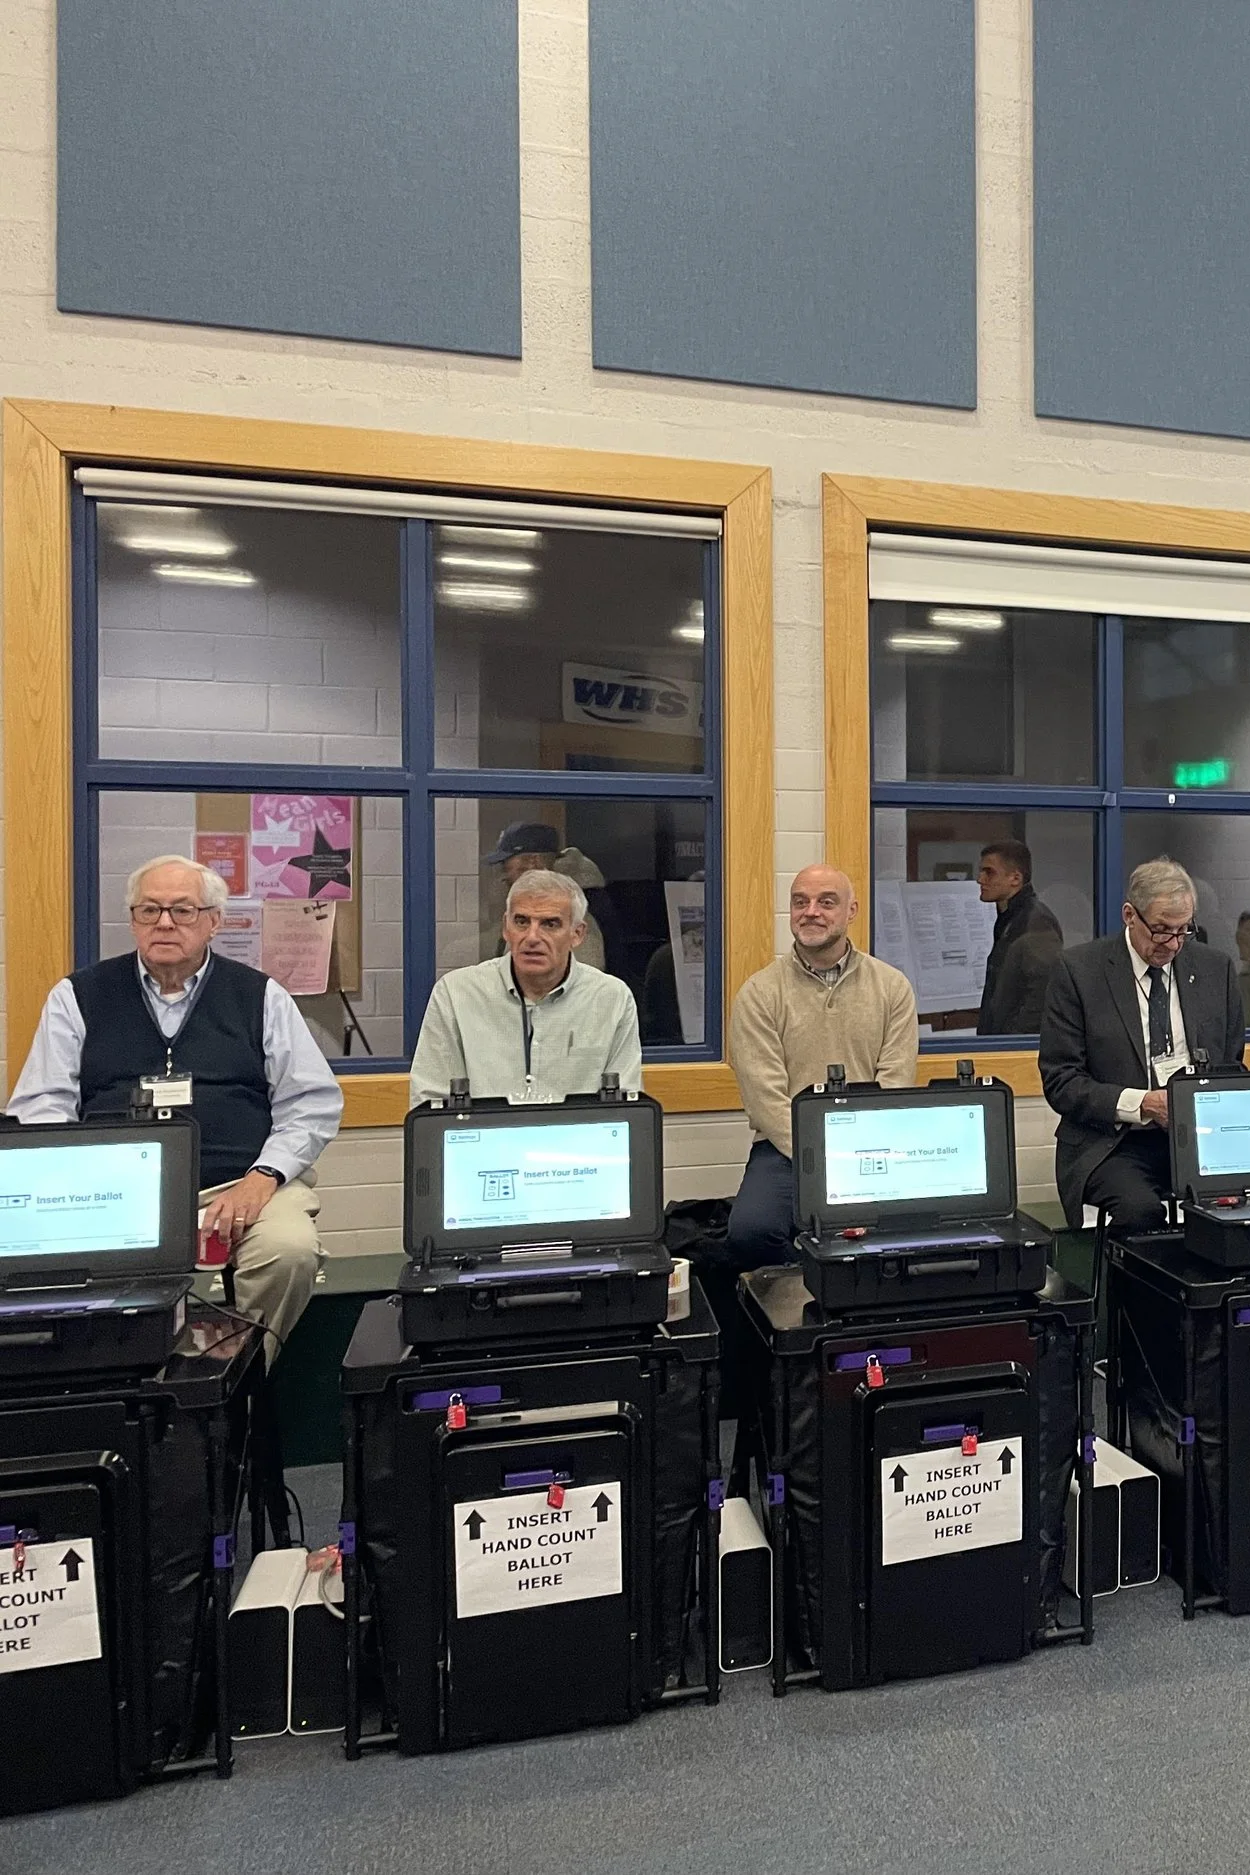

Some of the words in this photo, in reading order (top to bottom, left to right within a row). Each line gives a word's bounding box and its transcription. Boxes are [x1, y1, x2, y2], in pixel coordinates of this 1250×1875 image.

[573, 678, 690, 718] WHS
[293, 811, 346, 833] Girls
[141, 1151, 147, 1159] 0
[524, 1169, 549, 1178] Insert
[552, 1168, 571, 1176] Your
[573, 1167, 598, 1176] Ballot
[36, 1195, 66, 1204] Insert
[94, 1192, 122, 1200] Ballot
[926, 1464, 981, 1482] INSERT
[904, 1490, 946, 1506] HAND
[952, 1480, 1002, 1498] COUNT
[508, 1510, 572, 1530] INSERT
[926, 1502, 982, 1522] BALLOT
[934, 1523, 972, 1539] HERE
[482, 1538, 532, 1554] HAND
[538, 1528, 596, 1546] COUNT
[508, 1552, 572, 1572] BALLOT
[0, 1568, 38, 1586] ERT
[518, 1573, 562, 1590] HERE
[0, 1614, 40, 1632] LOT
